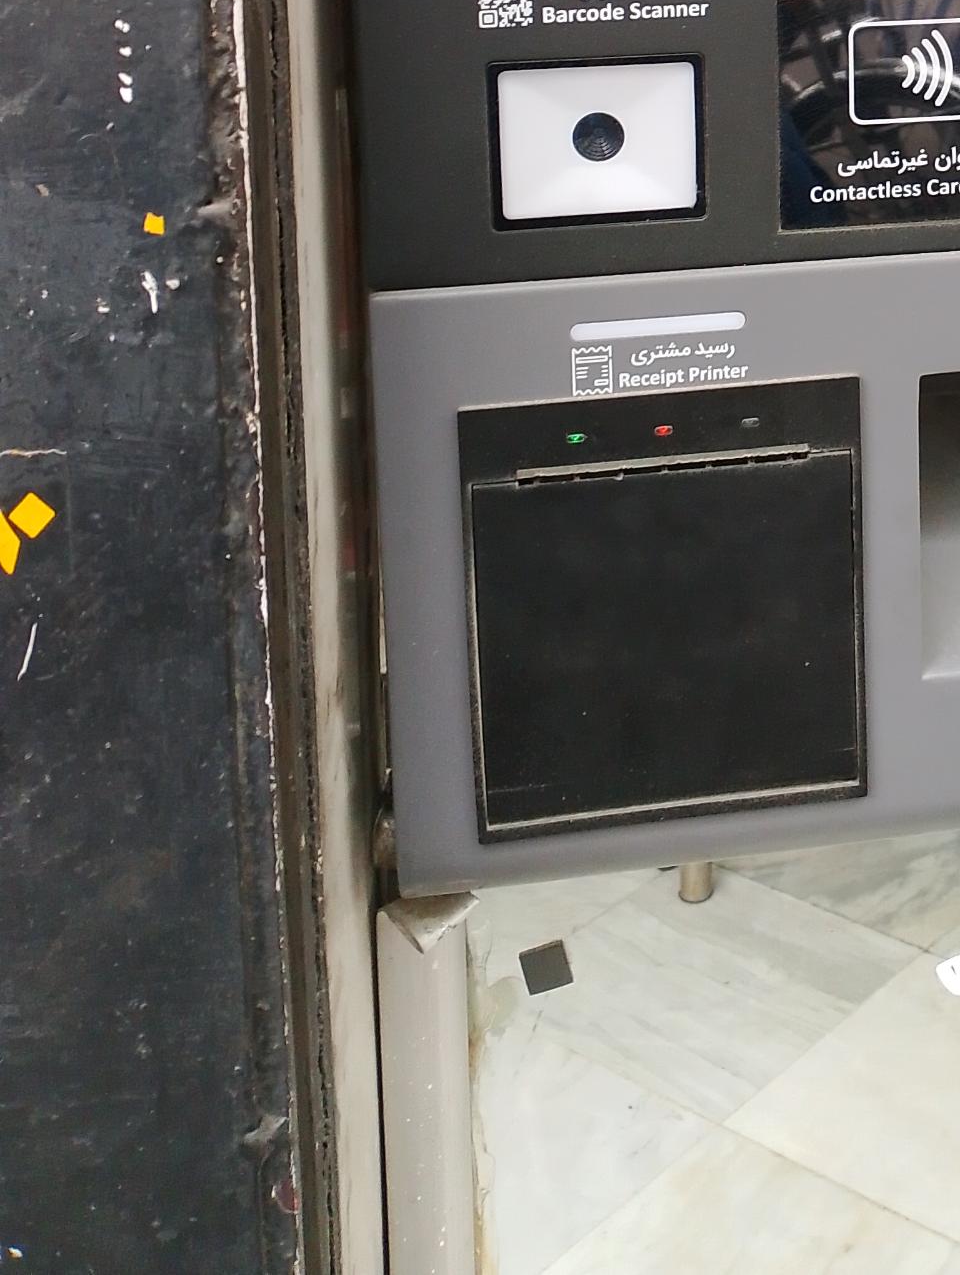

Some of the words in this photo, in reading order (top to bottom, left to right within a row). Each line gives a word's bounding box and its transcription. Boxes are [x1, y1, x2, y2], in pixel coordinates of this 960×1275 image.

[541, 2, 625, 25] Barcode
[629, 1, 710, 20] Scanner
[837, 148, 929, 177] غیرتماسی
[809, 180, 922, 204] Contactless
[630, 341, 692, 367] مشتری
[694, 340, 737, 358] رسید
[618, 368, 686, 389] Receipt
[688, 365, 750, 383] Printer
